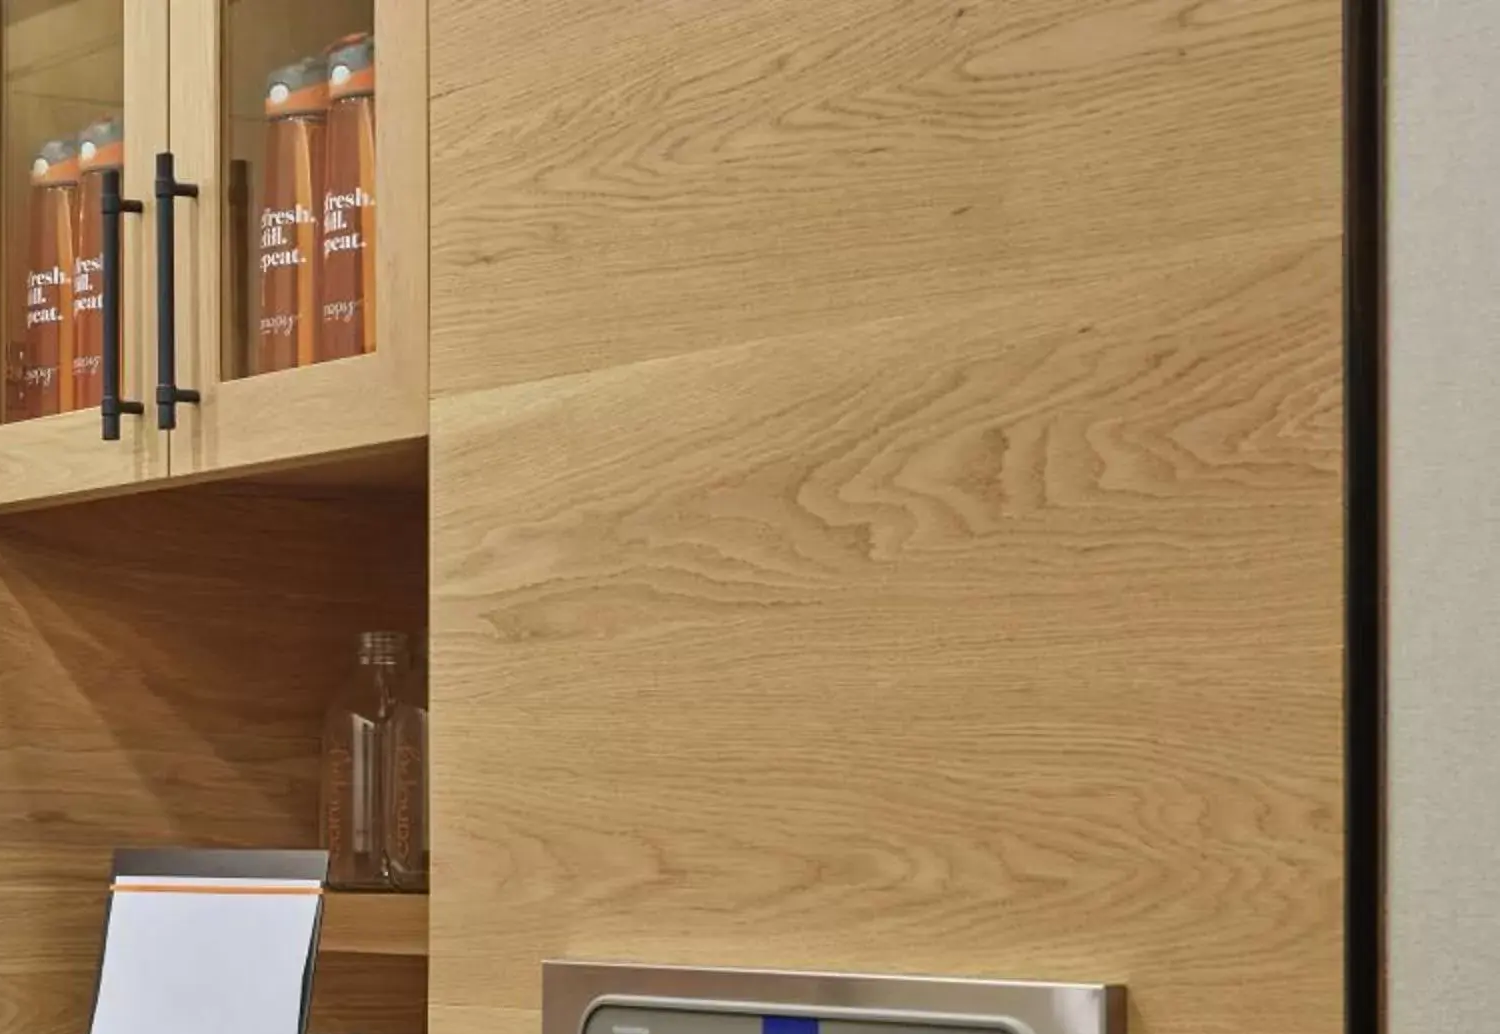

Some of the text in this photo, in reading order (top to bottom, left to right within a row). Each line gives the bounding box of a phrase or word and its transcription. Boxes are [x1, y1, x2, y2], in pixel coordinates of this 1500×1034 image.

[324, 187, 376, 212] fresh.
[261, 203, 317, 229] fresh.
[324, 233, 368, 260] peat.
[260, 248, 307, 273] peat.
